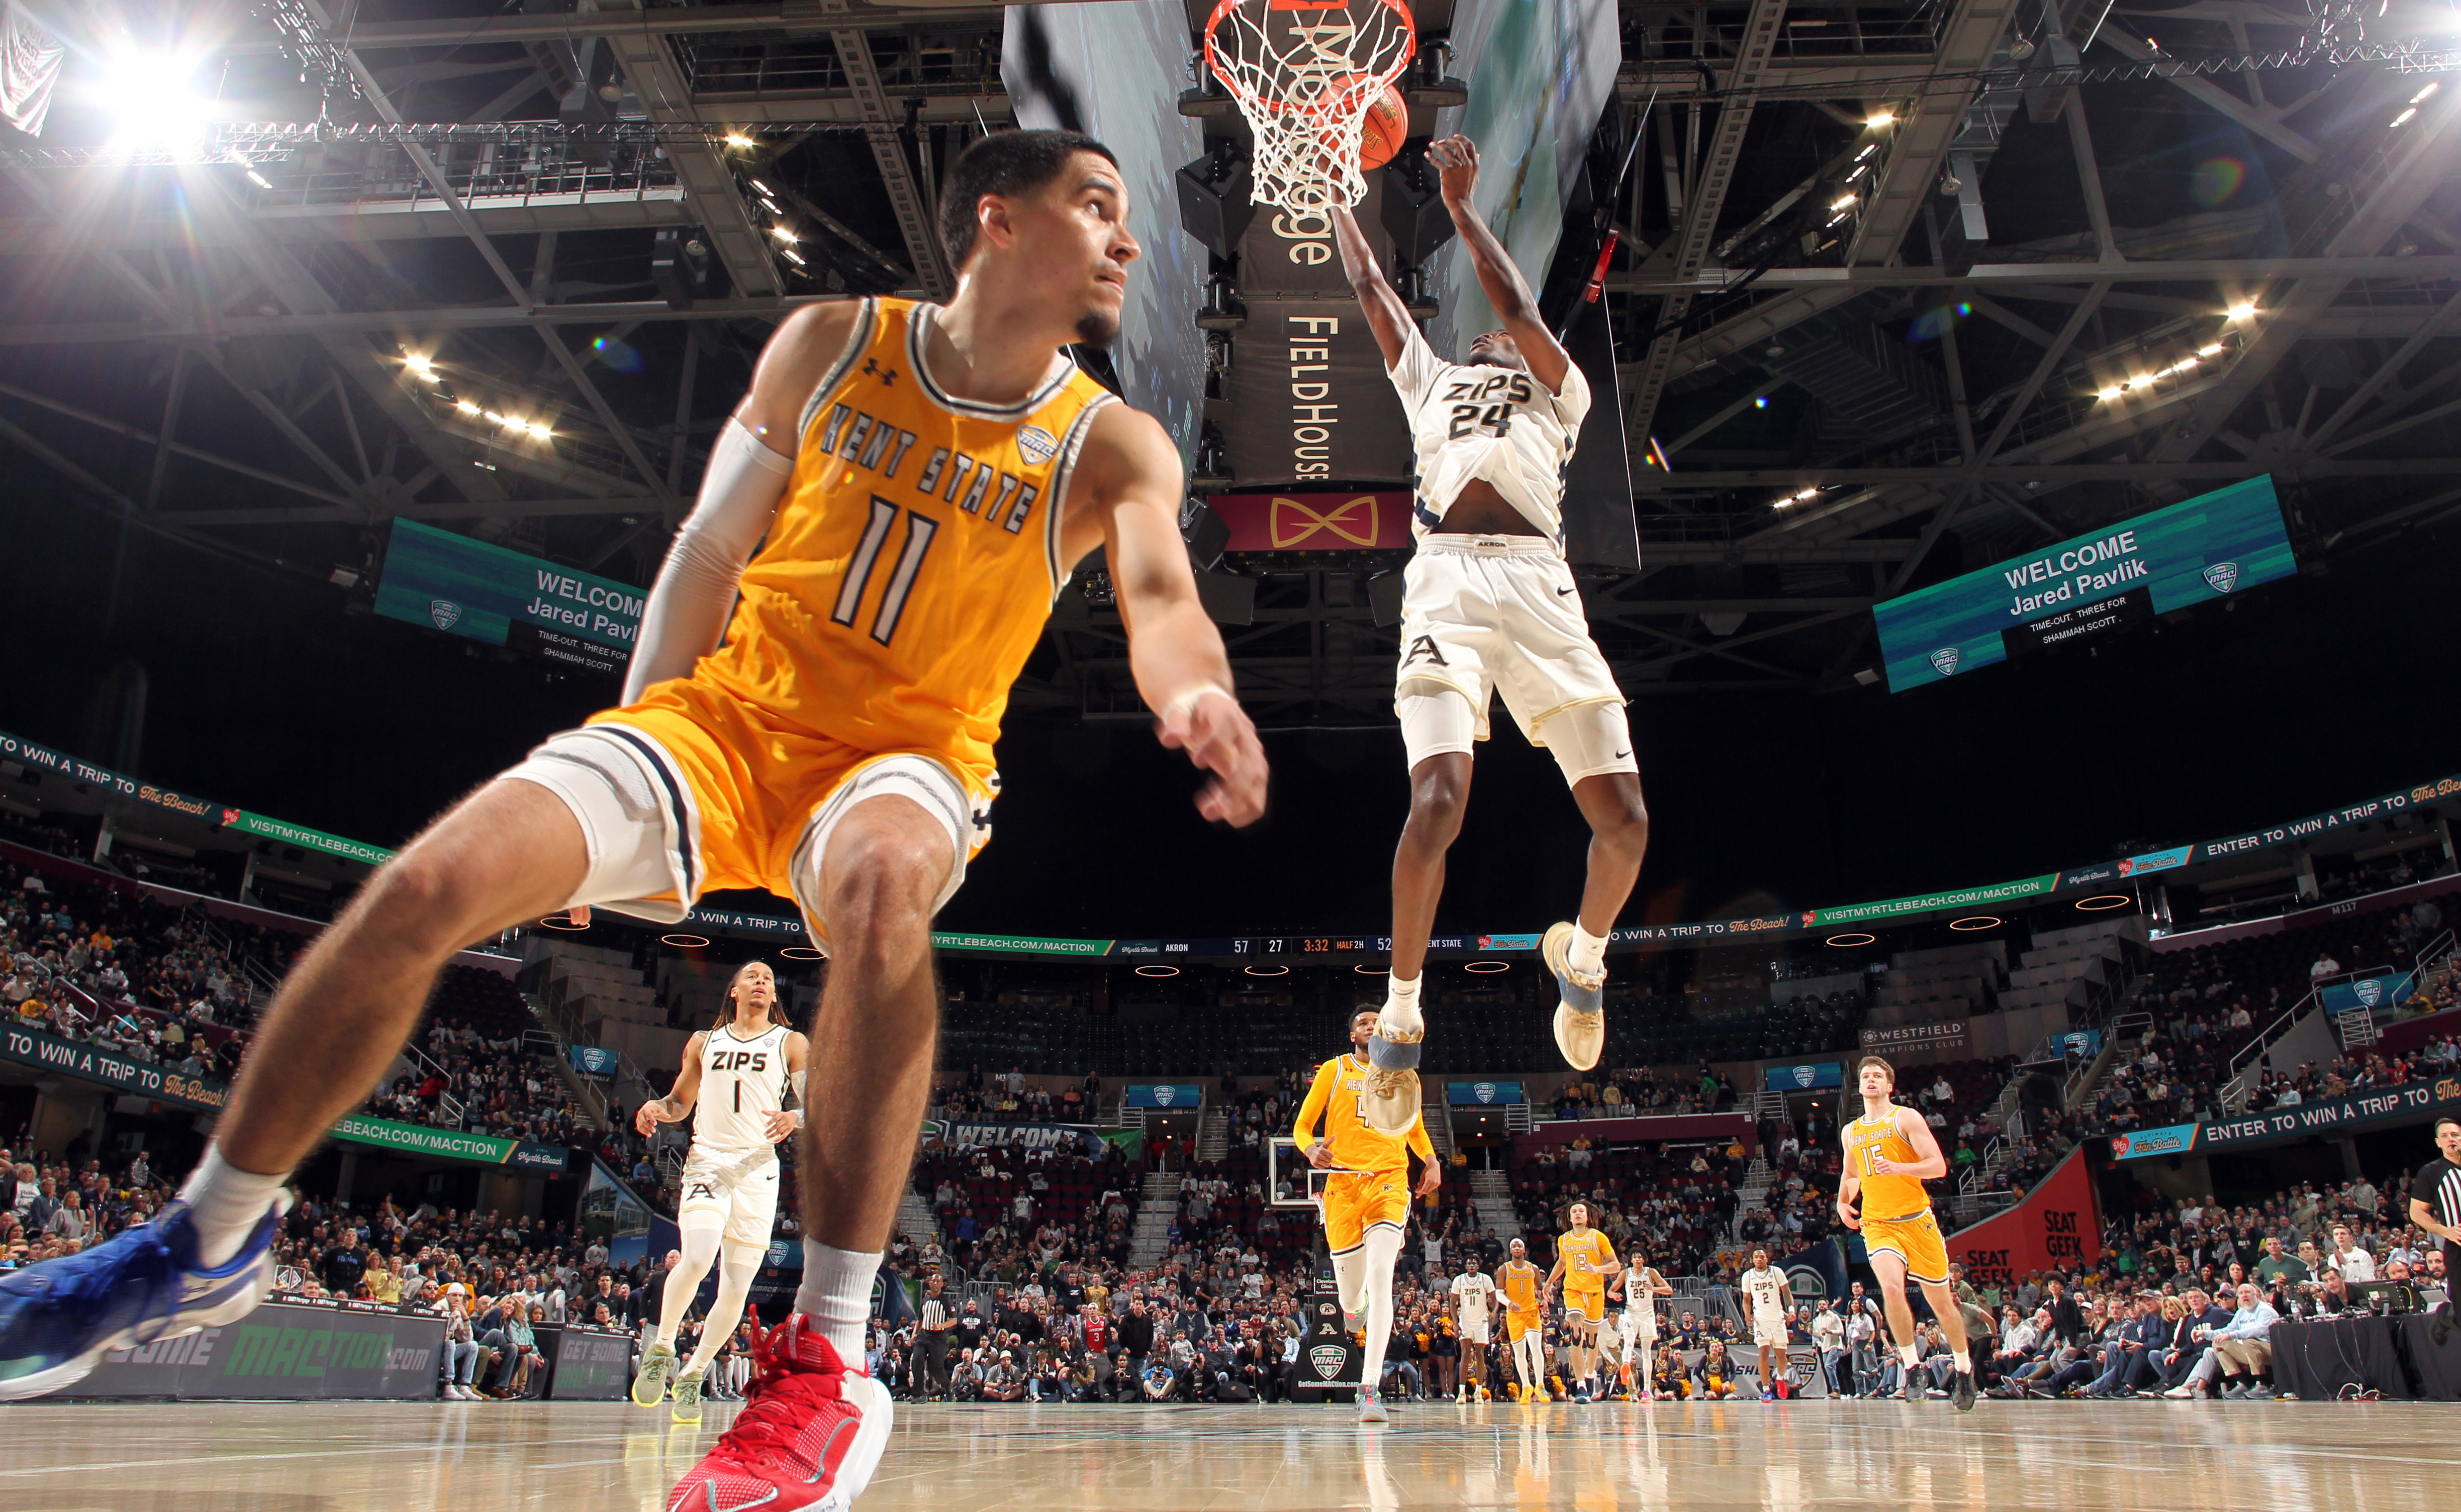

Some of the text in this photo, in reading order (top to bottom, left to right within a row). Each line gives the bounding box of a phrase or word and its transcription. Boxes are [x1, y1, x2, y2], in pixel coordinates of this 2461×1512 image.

[1441, 373, 1532, 405] ZIPS
[1289, 317, 1338, 481] FIELDHOUSE
[1449, 403, 1513, 441] 24
[1020, 435, 1058, 455] MAC
[821, 402, 1038, 535] KENT STATE
[2004, 531, 2138, 589] WELCOME
[830, 493, 940, 648] 11
[2206, 572, 2236, 583] MAC
[537, 569, 645, 618] WELCOM
[2011, 558, 2149, 616] Jared Pavlik
[433, 609, 457, 620] MAC
[528, 597, 638, 642] Jared Pavl
[2030, 597, 2127, 632] TIME-OUT. THREE FOR
[2043, 616, 2117, 644] SHAMMAH SCOTT
[539, 630, 627, 660] TIME-OUT. THREE FOR
[1400, 634, 1448, 671] A
[544, 648, 613, 672] SHAMMAH SCOTT
[1934, 656, 1958, 666] MAC
[0, 736, 211, 816] TO WIN A TRIP TO The Beach!
[2207, 785, 2436, 856] ENTER TO WIN A TRIP TO The
[250, 819, 395, 863] VISITMYRTLEBEACH.CO
[2137, 857, 2177, 871] Fan Battle
[2069, 871, 2109, 884] Myrtle Beach
[1824, 881, 2039, 921] VISITMYRTLEBEACH.COM/MACTION
[2331, 902, 2357, 915] M117
[701, 912, 799, 932] WIN A TRIP TO
[1625, 916, 1789, 940] WIN A TRIP TO The Beach!
[1121, 945, 1140, 954] Myrtle
[1165, 944, 1188, 952] AKRON
[1235, 940, 1249, 953] 57
[1269, 940, 1283, 952] 27
[1304, 939, 1329, 952] 3:32
[1337, 940, 1364, 950] HALF 2H
[1377, 938, 1392, 951] 52
[1442, 939, 1461, 947] STATE
[1494, 939, 1529, 949] Fan Battle
[2359, 987, 2378, 996] MAC
[1879, 1024, 1961, 1040] WESTFIELD
[1867, 1040, 1963, 1055] CHAMPIONS CLUB
[9, 1032, 227, 1106] TO WIN A TRIP TO The Beach!
[711, 1052, 767, 1072] ZIPS
[1347, 1079, 1362, 1091] KEN
[734, 1080, 740, 1113] 1
[2207, 1078, 2461, 1142] ENTER TO WIN A TRIP TO The
[957, 1126, 1078, 1148] WELCOME
[1870, 1128, 1892, 1142] STATE
[2113, 1141, 2127, 1152] MB
[2134, 1137, 2181, 1153] Fan Battle
[518, 1152, 562, 1165] Myrtle Beach
[1862, 1144, 1884, 1176] 15
[686, 1184, 716, 1201] A
[2044, 1210, 2077, 1233] SEAT
[2046, 1235, 2084, 1257] GEEK
[1573, 1253, 1586, 1271] 13
[1967, 1250, 2009, 1267] SEAT
[1970, 1269, 2016, 1285] GEEK
[1520, 1280, 1523, 1293] 1
[1634, 1289, 1644, 1298] 25
[1754, 1281, 1773, 1291] ZIPS
[1470, 1296, 1475, 1305] 11
[1762, 1292, 1770, 1303] 2
[962, 1317, 980, 1325] AKRON
[1319, 1323, 1338, 1335] A
[1094, 1333, 1099, 1342] 3
[563, 1340, 626, 1362] GET SOME
[1314, 1356, 1342, 1364] MAC
